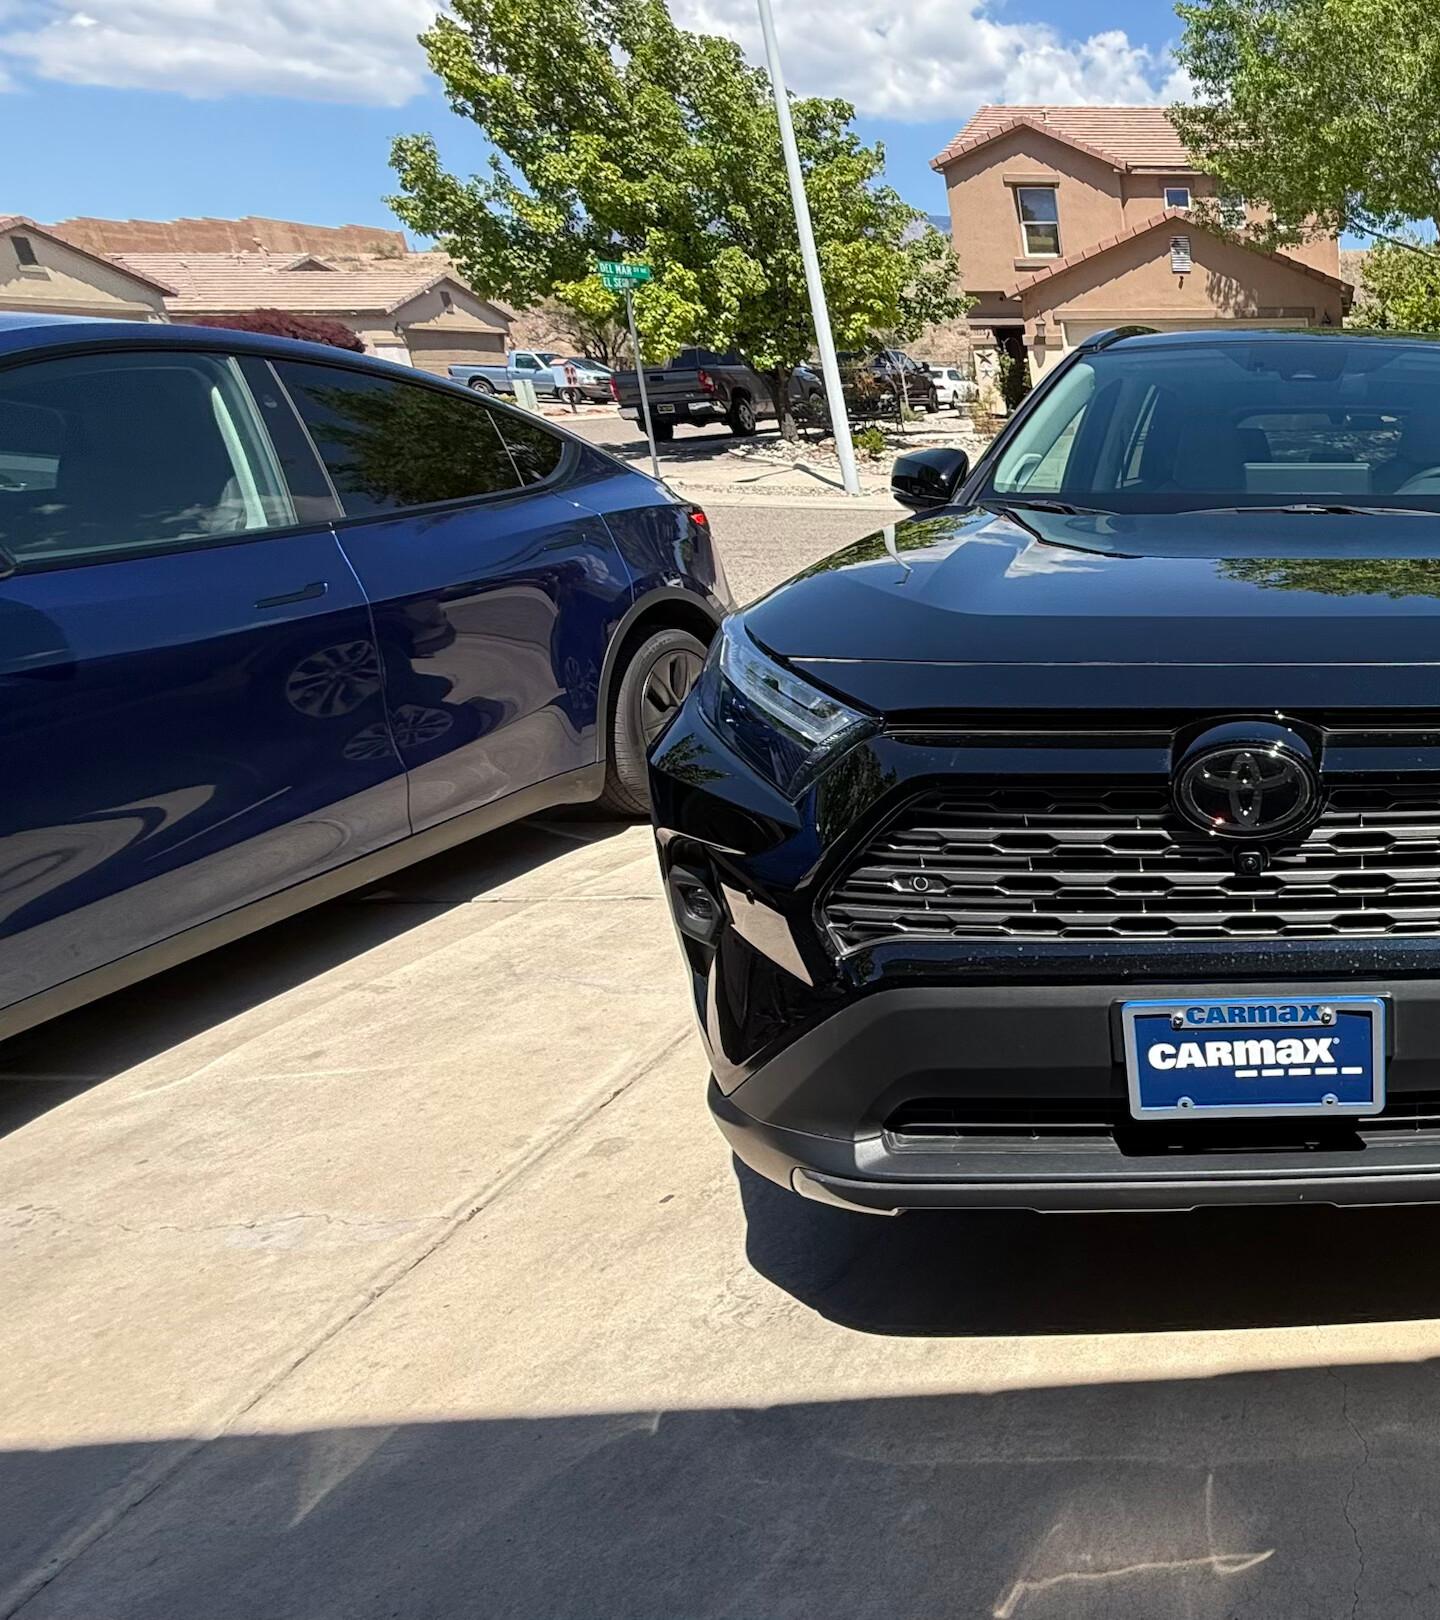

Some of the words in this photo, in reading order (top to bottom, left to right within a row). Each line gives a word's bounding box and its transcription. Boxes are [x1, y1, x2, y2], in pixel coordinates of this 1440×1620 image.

[600, 262, 614, 274] DEL
[616, 264, 632, 276] MAR
[603, 277, 613, 288] EL
